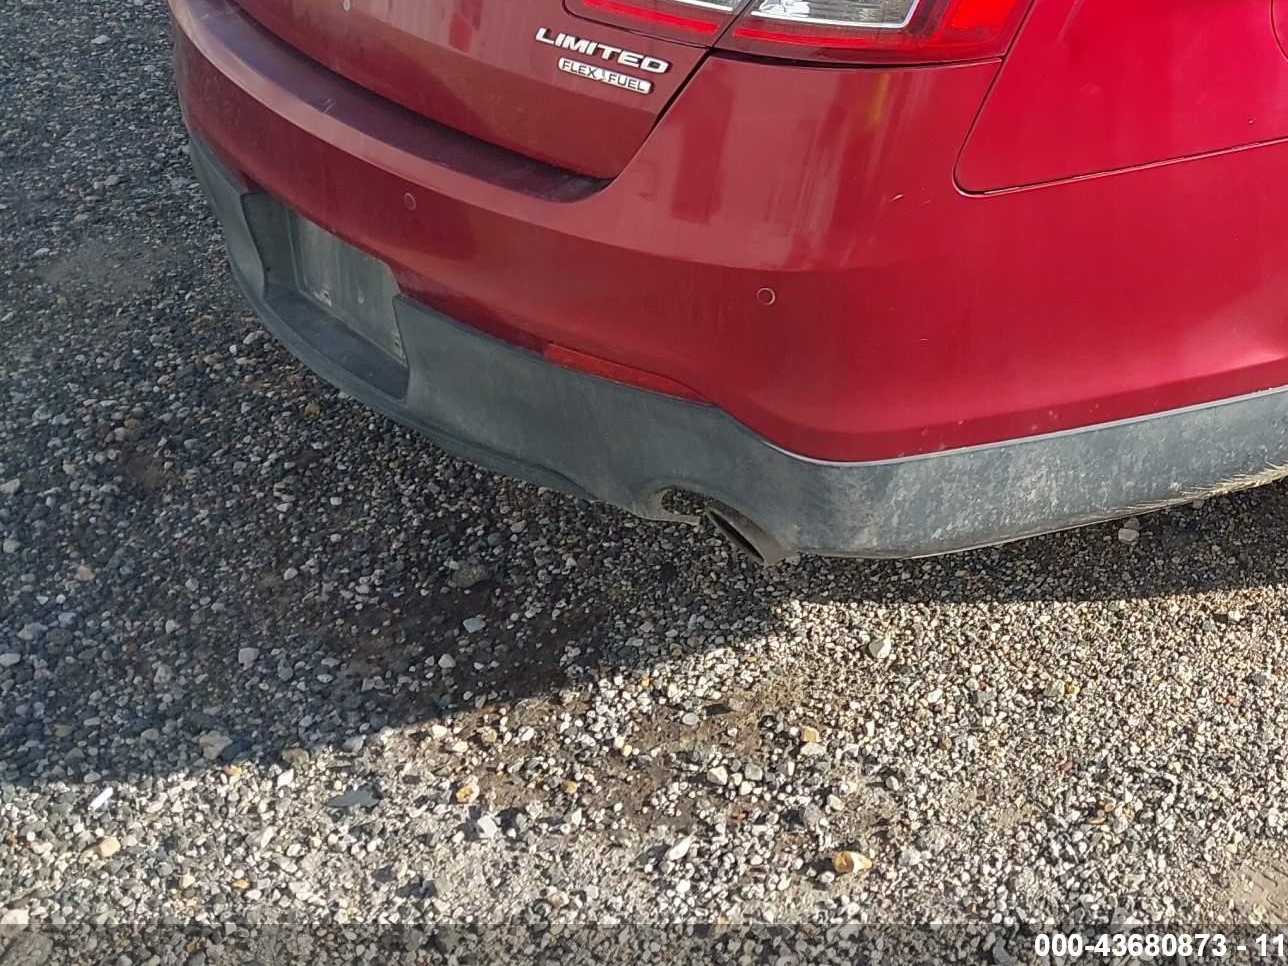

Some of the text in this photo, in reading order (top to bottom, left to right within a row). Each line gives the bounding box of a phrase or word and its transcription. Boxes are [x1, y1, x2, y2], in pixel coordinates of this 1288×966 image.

[535, 27, 670, 74] LIMITED
[562, 60, 646, 92] FLEX FUEL
